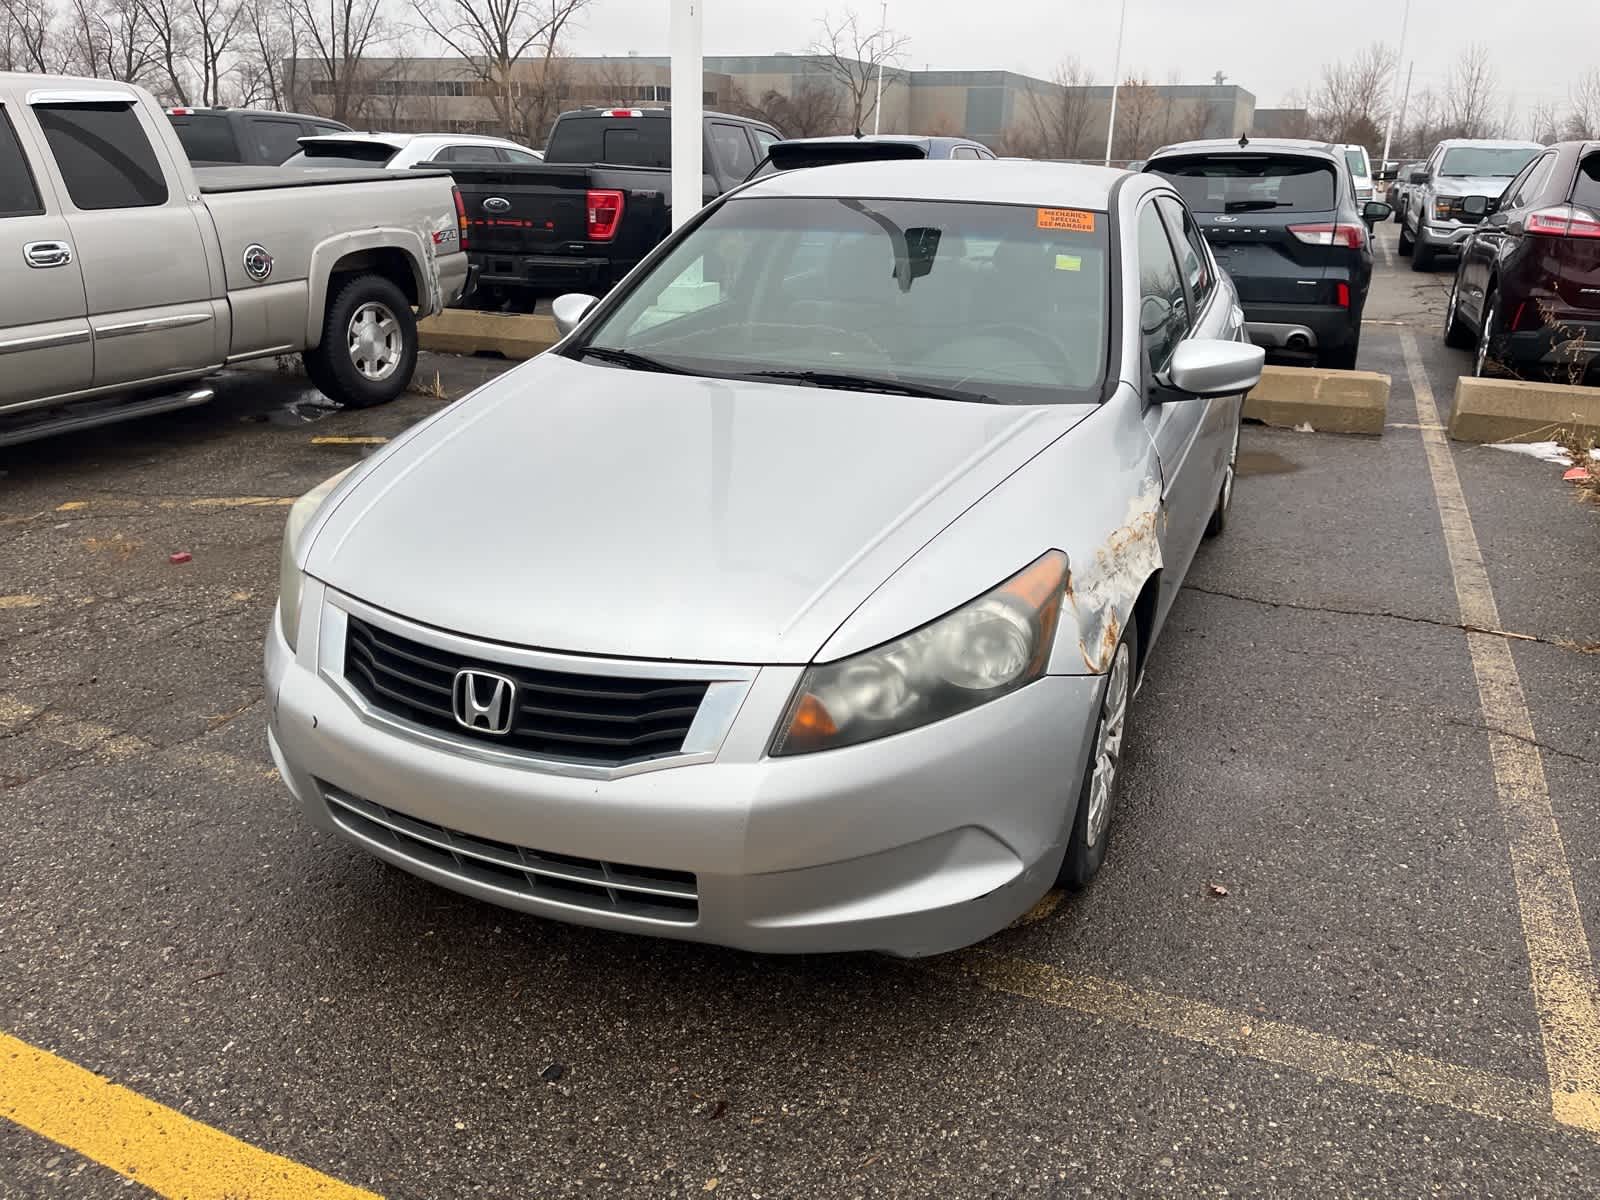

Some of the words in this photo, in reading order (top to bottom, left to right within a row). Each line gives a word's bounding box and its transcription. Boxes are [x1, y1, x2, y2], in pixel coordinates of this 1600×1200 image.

[1044, 210, 1089, 219] MECHANICS
[1050, 216, 1081, 224] SPECIAL
[1055, 222, 1092, 230] MANAGER
